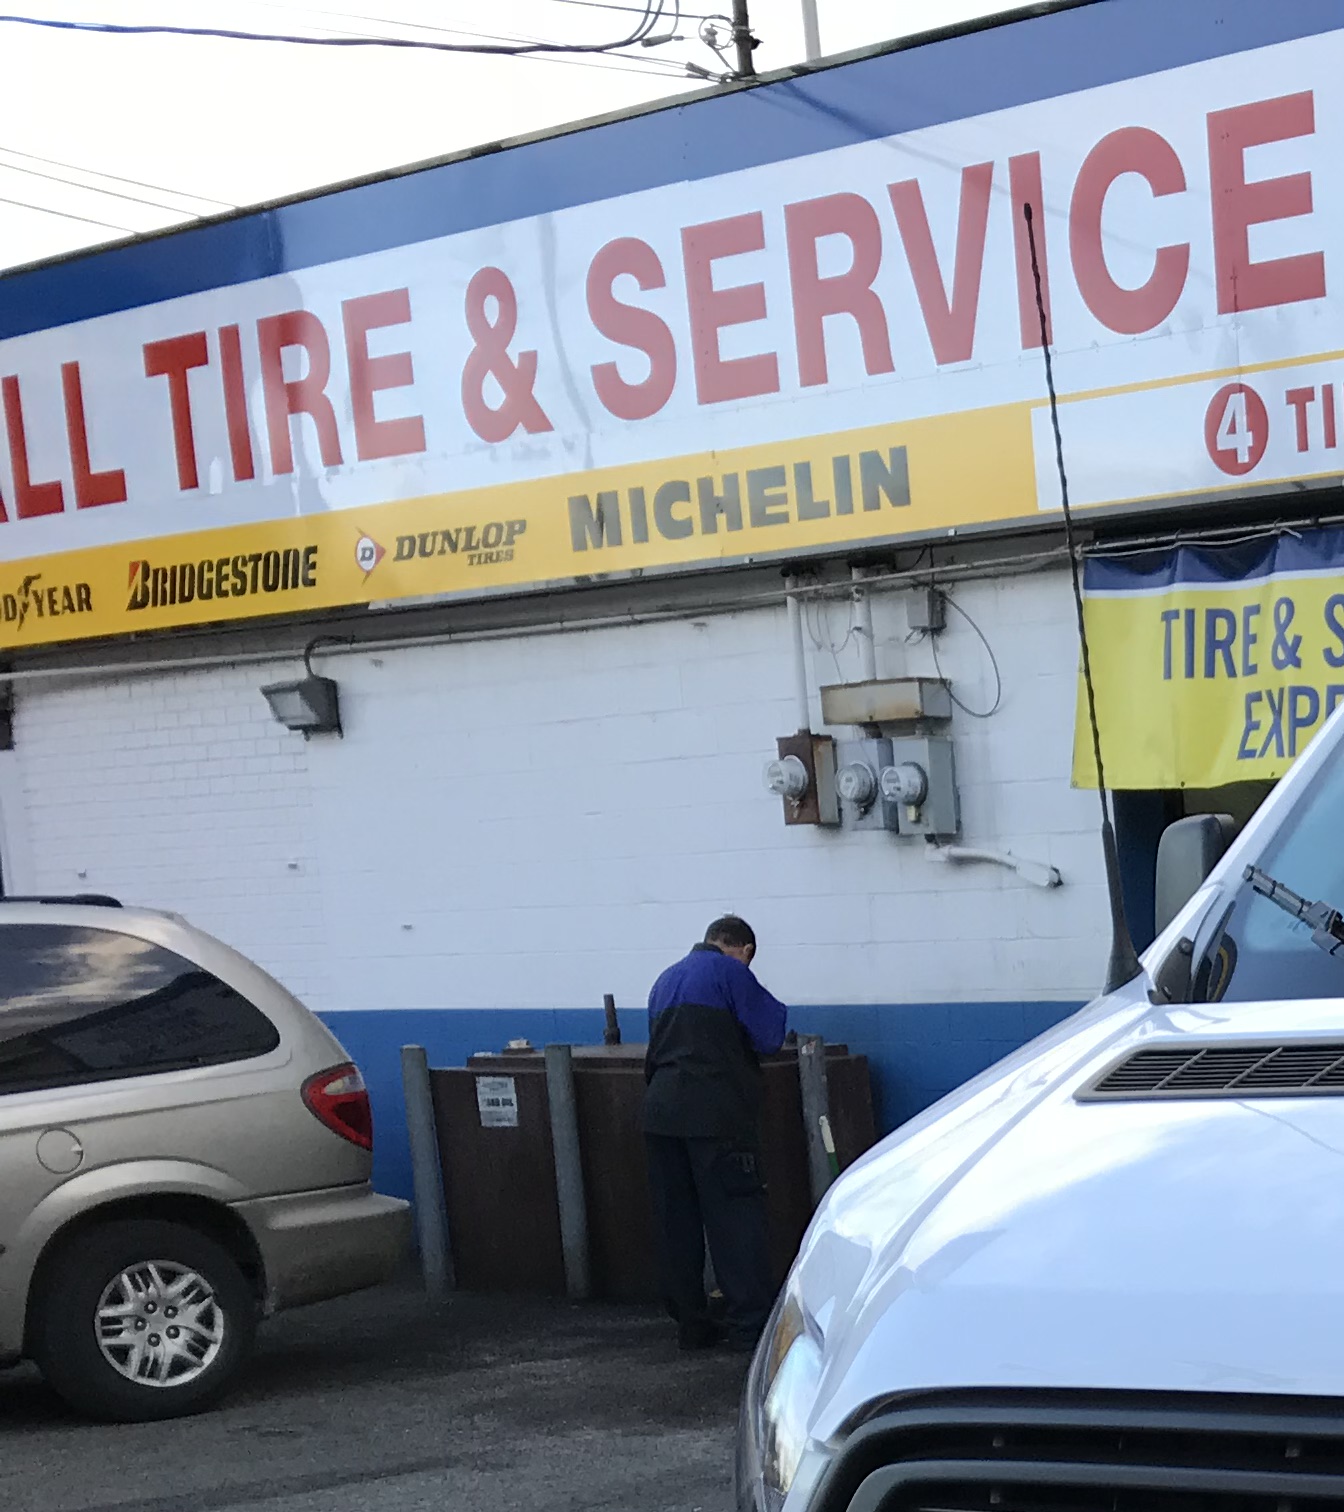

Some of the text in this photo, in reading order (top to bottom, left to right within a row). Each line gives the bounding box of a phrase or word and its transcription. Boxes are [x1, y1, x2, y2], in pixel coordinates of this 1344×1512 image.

[0, 90, 1326, 522] LL TIRE & SERVICE
[1213, 390, 1256, 467] 4
[567, 445, 912, 552] MICHELIN
[393, 519, 527, 562] DUNLOP
[467, 549, 514, 567] TIRES
[0, 577, 92, 630] DYEAR
[126, 546, 318, 612] BRIDGESTONE
[1160, 603, 1261, 681] TIRE
[1271, 596, 1303, 671] &
